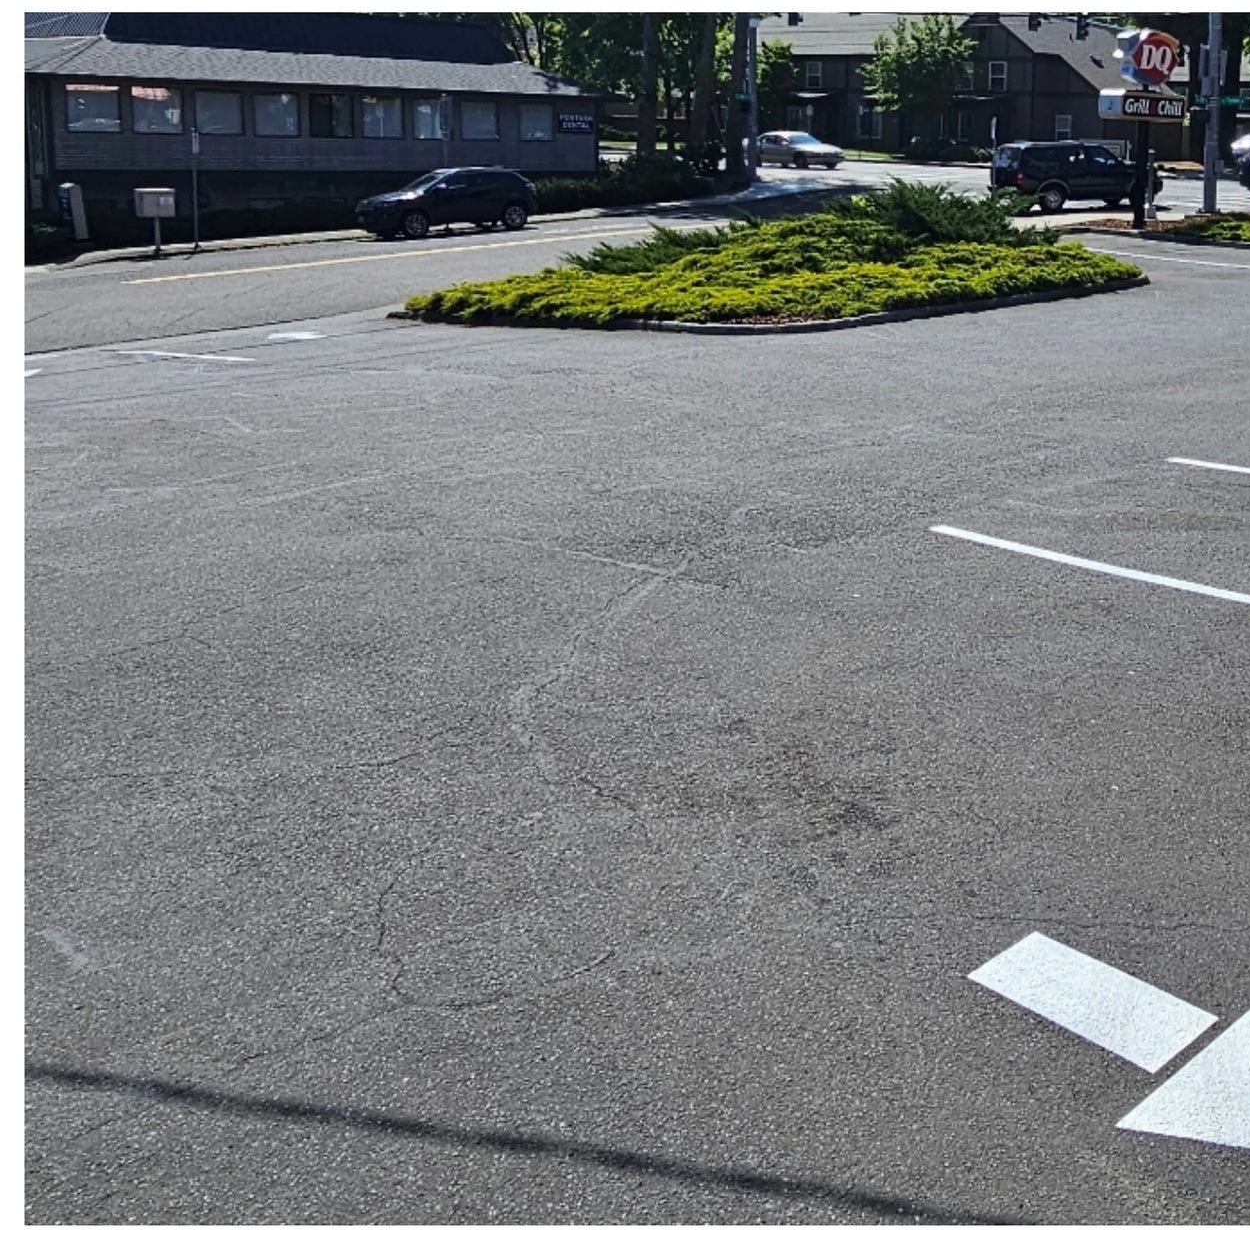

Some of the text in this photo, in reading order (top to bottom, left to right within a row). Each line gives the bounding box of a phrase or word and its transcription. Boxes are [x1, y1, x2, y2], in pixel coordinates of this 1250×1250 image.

[1140, 45, 1173, 75] DQ
[1124, 98, 1150, 114] Grill
[1157, 100, 1183, 116] Chill
